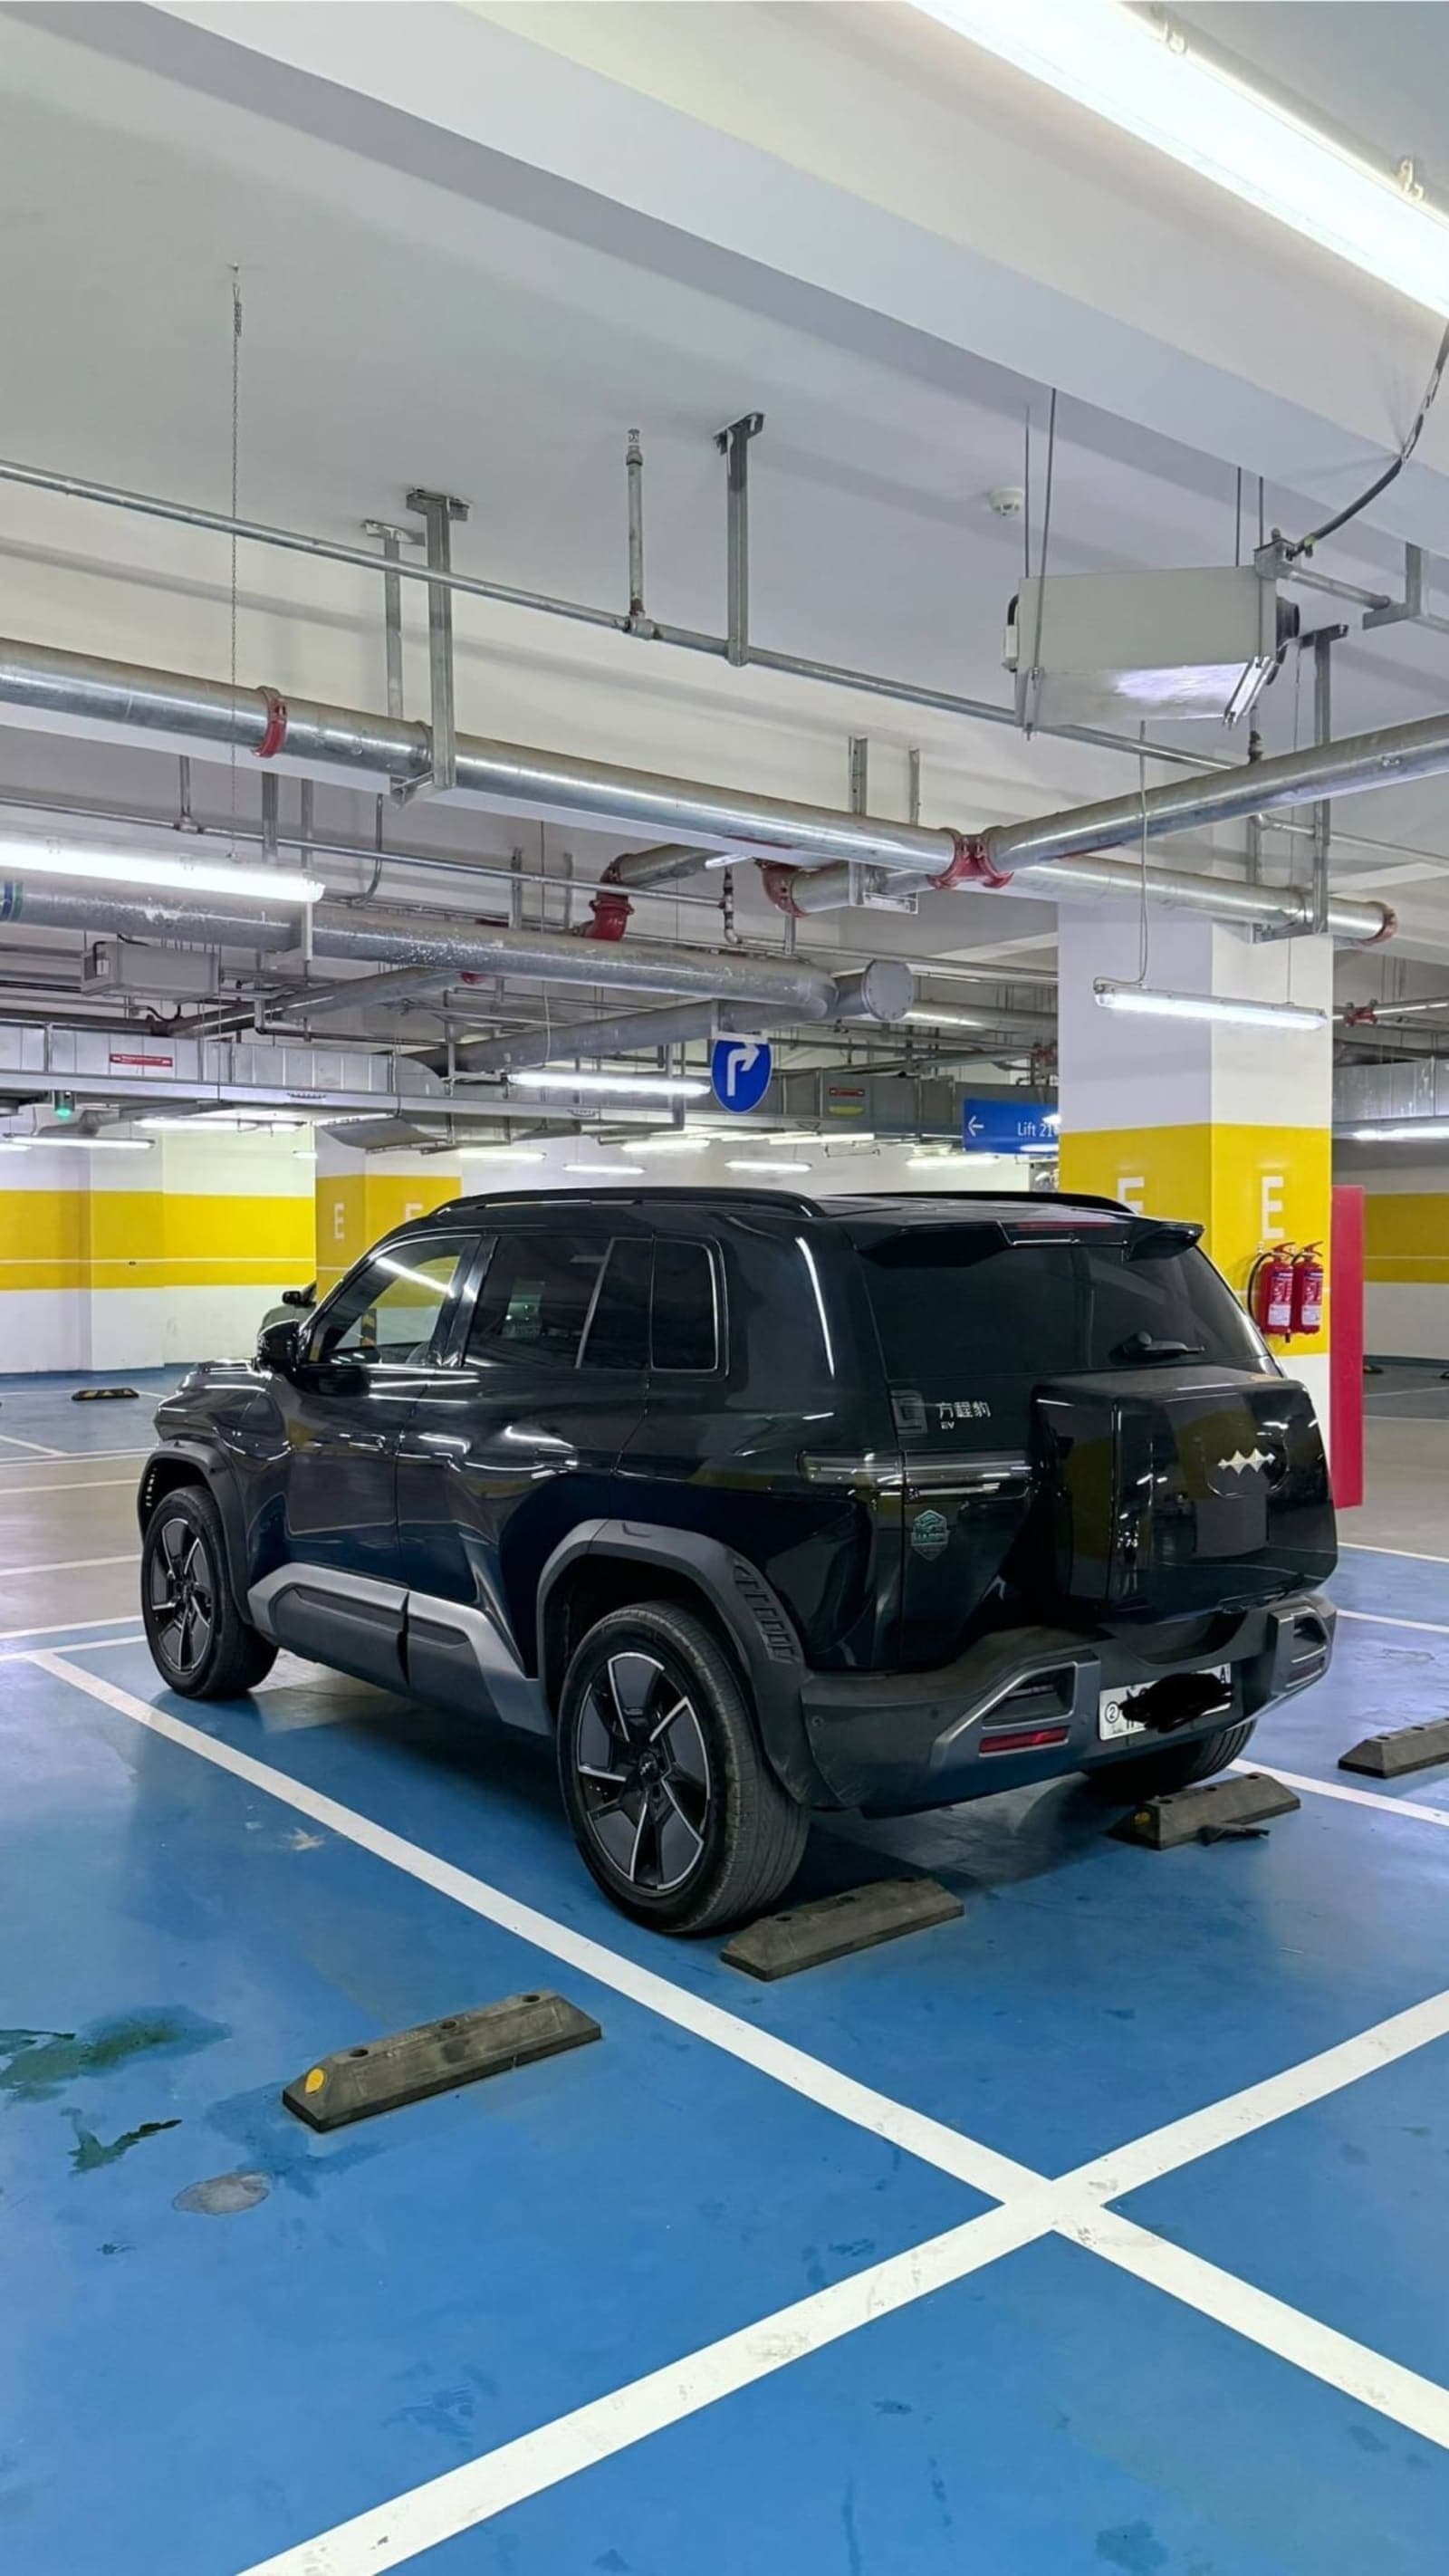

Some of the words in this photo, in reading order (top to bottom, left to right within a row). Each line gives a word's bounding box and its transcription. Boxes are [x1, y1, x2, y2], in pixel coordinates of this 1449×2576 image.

[1017, 1121, 1036, 1137] Lift
[1262, 1176, 1284, 1239] E
[334, 1202, 344, 1239] E
[936, 1400, 991, 1419] 方程豹
[941, 1421, 955, 1429] EV
